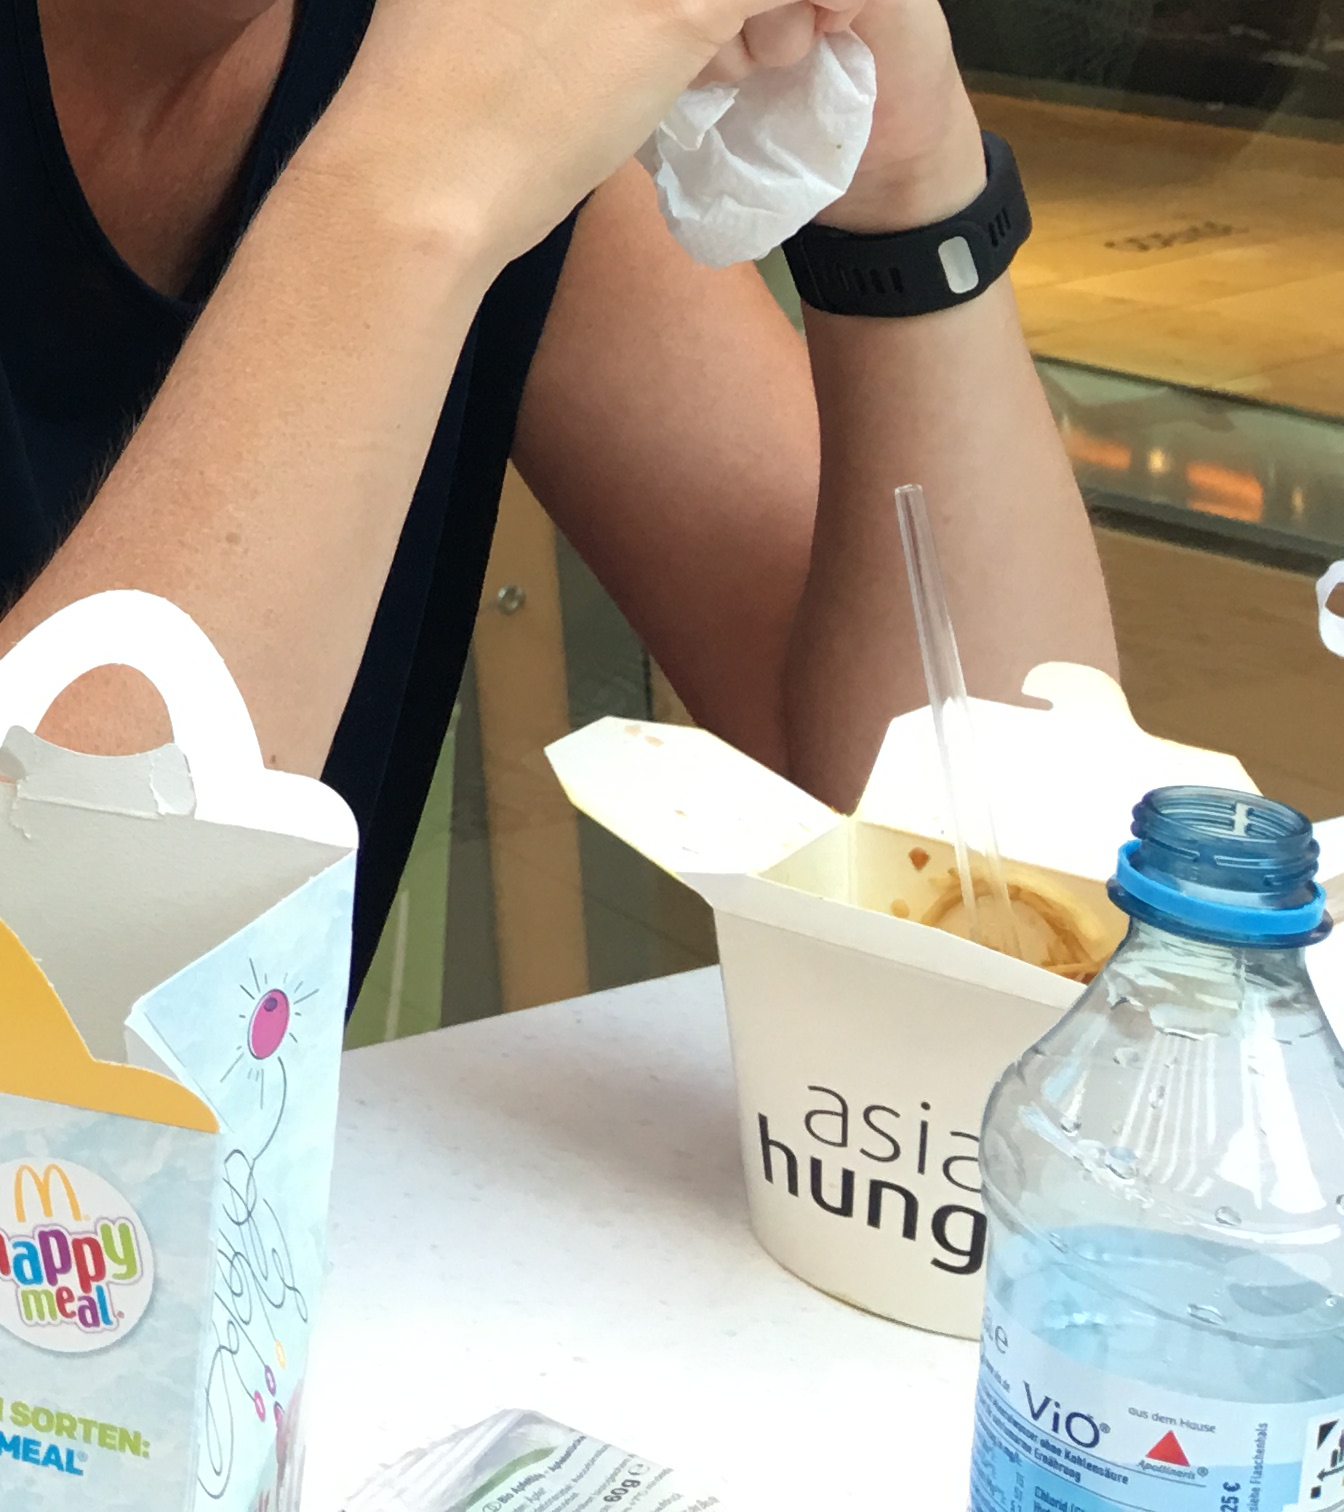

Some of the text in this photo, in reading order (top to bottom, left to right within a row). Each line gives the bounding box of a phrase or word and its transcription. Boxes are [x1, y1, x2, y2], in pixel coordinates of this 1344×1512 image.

[20, 1284, 114, 1329] meal
[10, 1401, 151, 1459] SORTEN:
[1128, 1406, 1216, 1434] aus dem Hause
[1064, 1447, 1130, 1486] Kohlensäure
[1250, 1422, 1269, 1485] Flaschenhals
